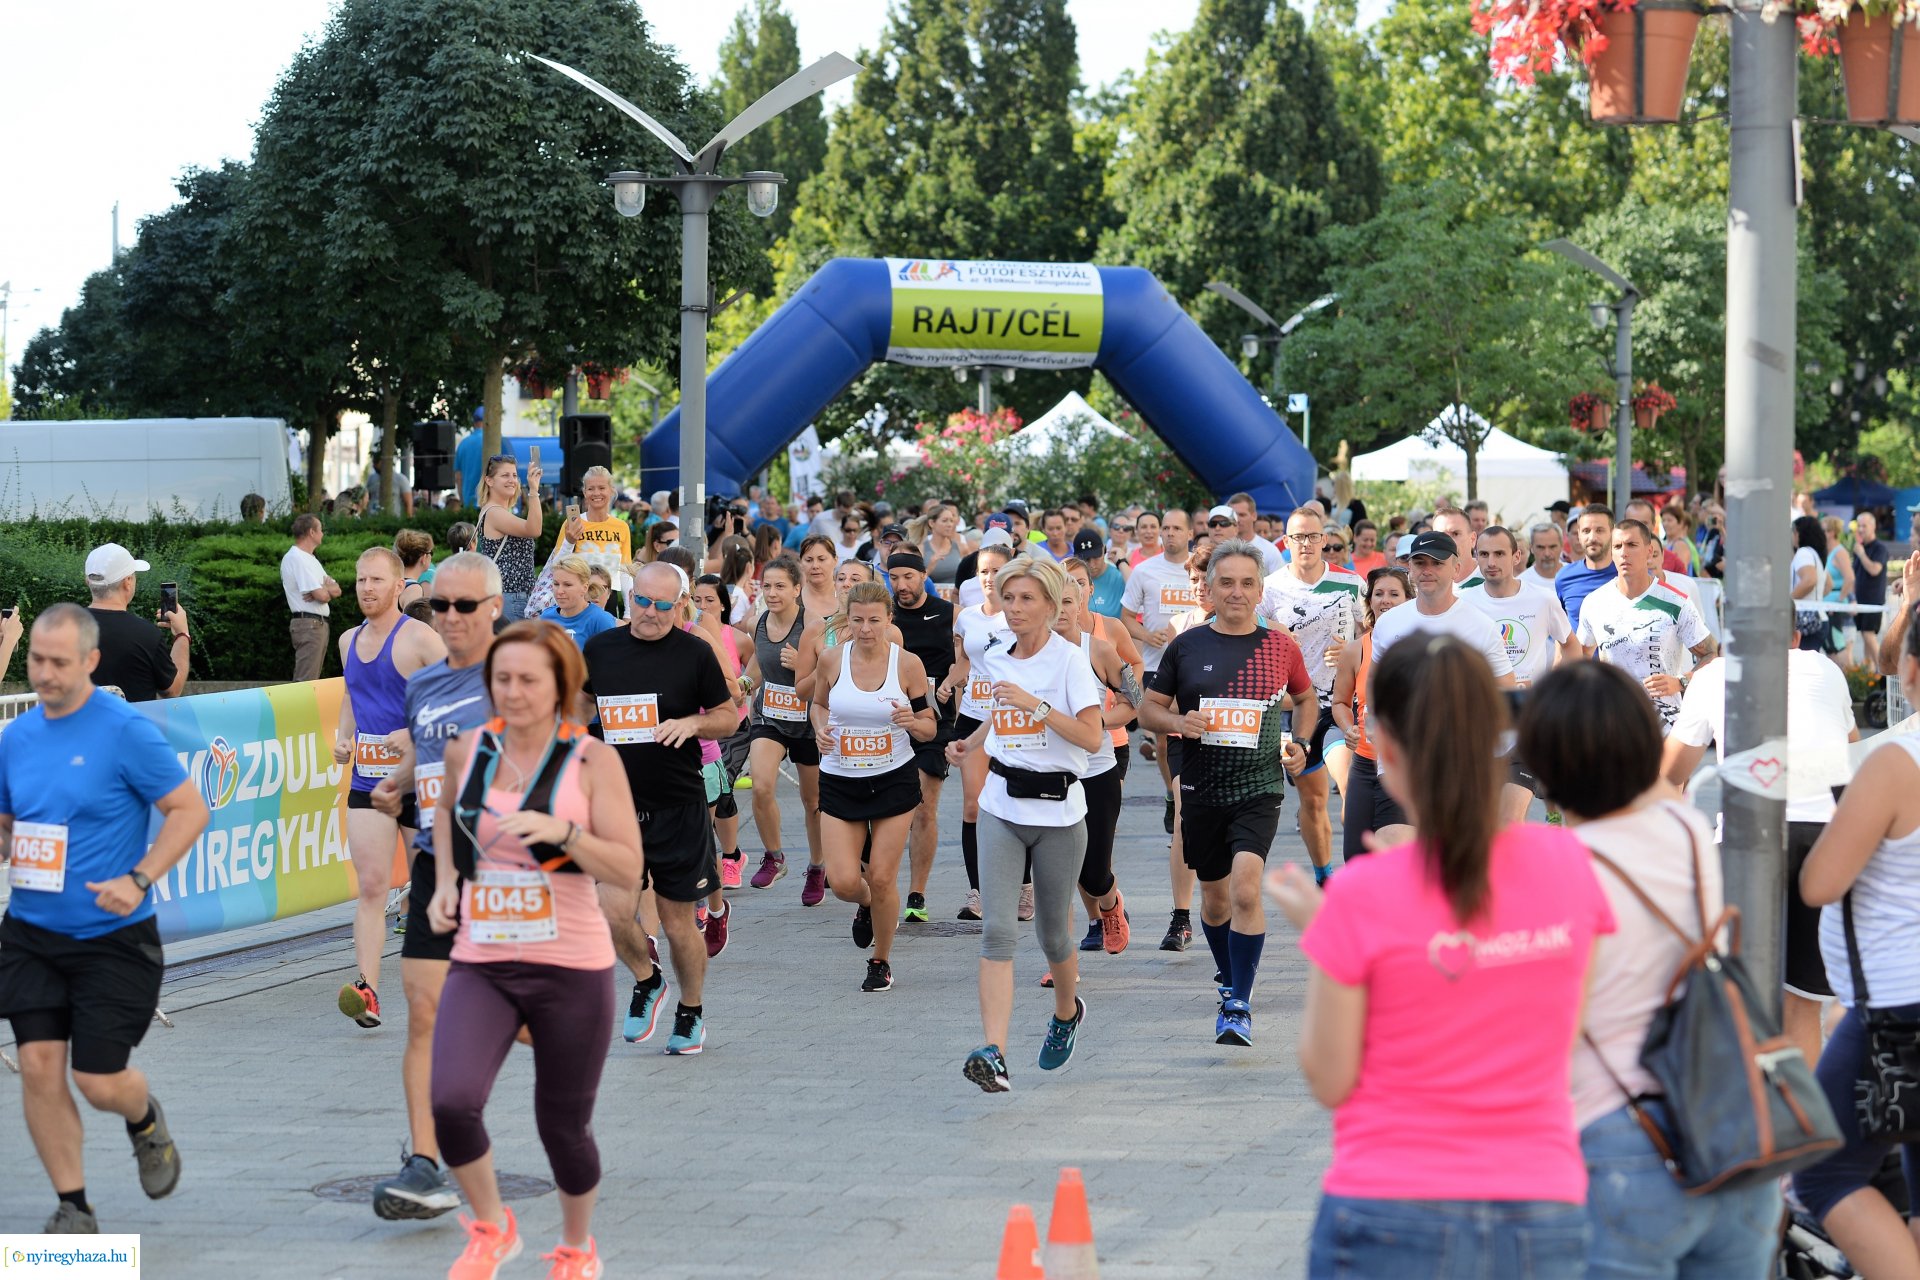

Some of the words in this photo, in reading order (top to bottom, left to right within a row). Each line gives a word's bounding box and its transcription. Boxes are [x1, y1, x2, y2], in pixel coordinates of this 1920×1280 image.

[912, 303, 1080, 338] RAJT/CÉL
[766, 691, 801, 707] 1091
[603, 705, 650, 724] 1141
[994, 711, 1038, 729] 1137
[1208, 709, 1255, 726] 1106
[423, 722, 459, 740] AIR
[844, 737, 888, 752] 1058
[474, 887, 542, 912] 1045
